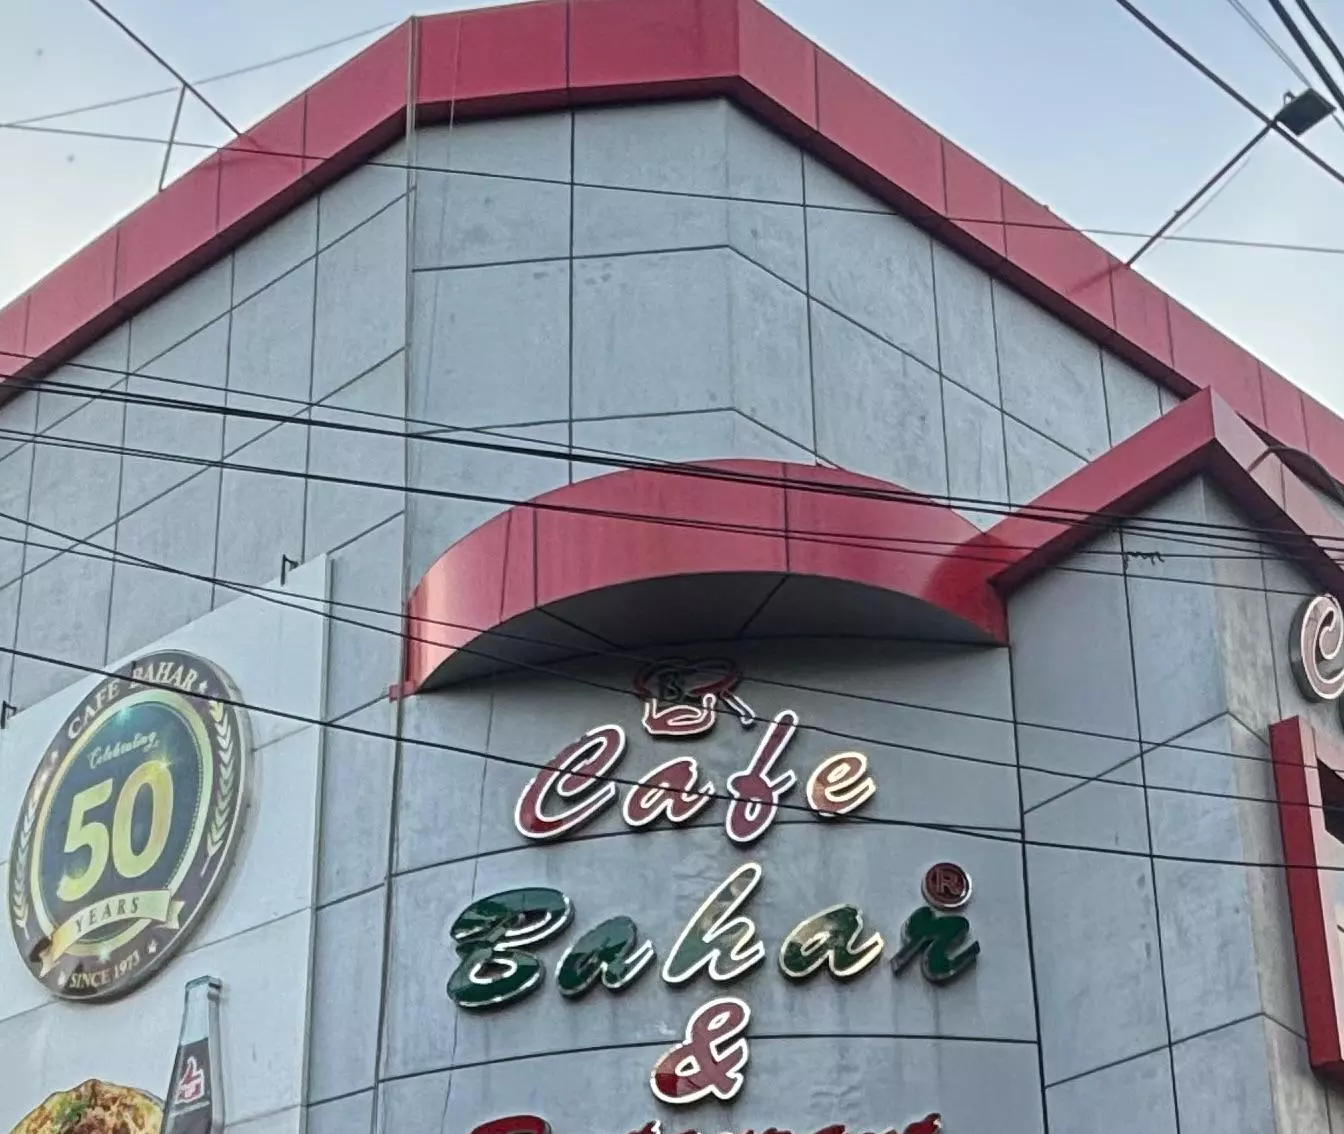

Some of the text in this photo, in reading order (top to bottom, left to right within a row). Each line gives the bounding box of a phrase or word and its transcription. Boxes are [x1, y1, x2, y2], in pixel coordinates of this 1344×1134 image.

[67, 661, 198, 740] CAFE BAHAR
[514, 709, 876, 842] Cafe
[56, 760, 174, 902] 50
[76, 896, 140, 933] YEARS
[446, 862, 980, 1008] Bahar
[69, 967, 113, 989] SINCE
[649, 997, 750, 1103] &
